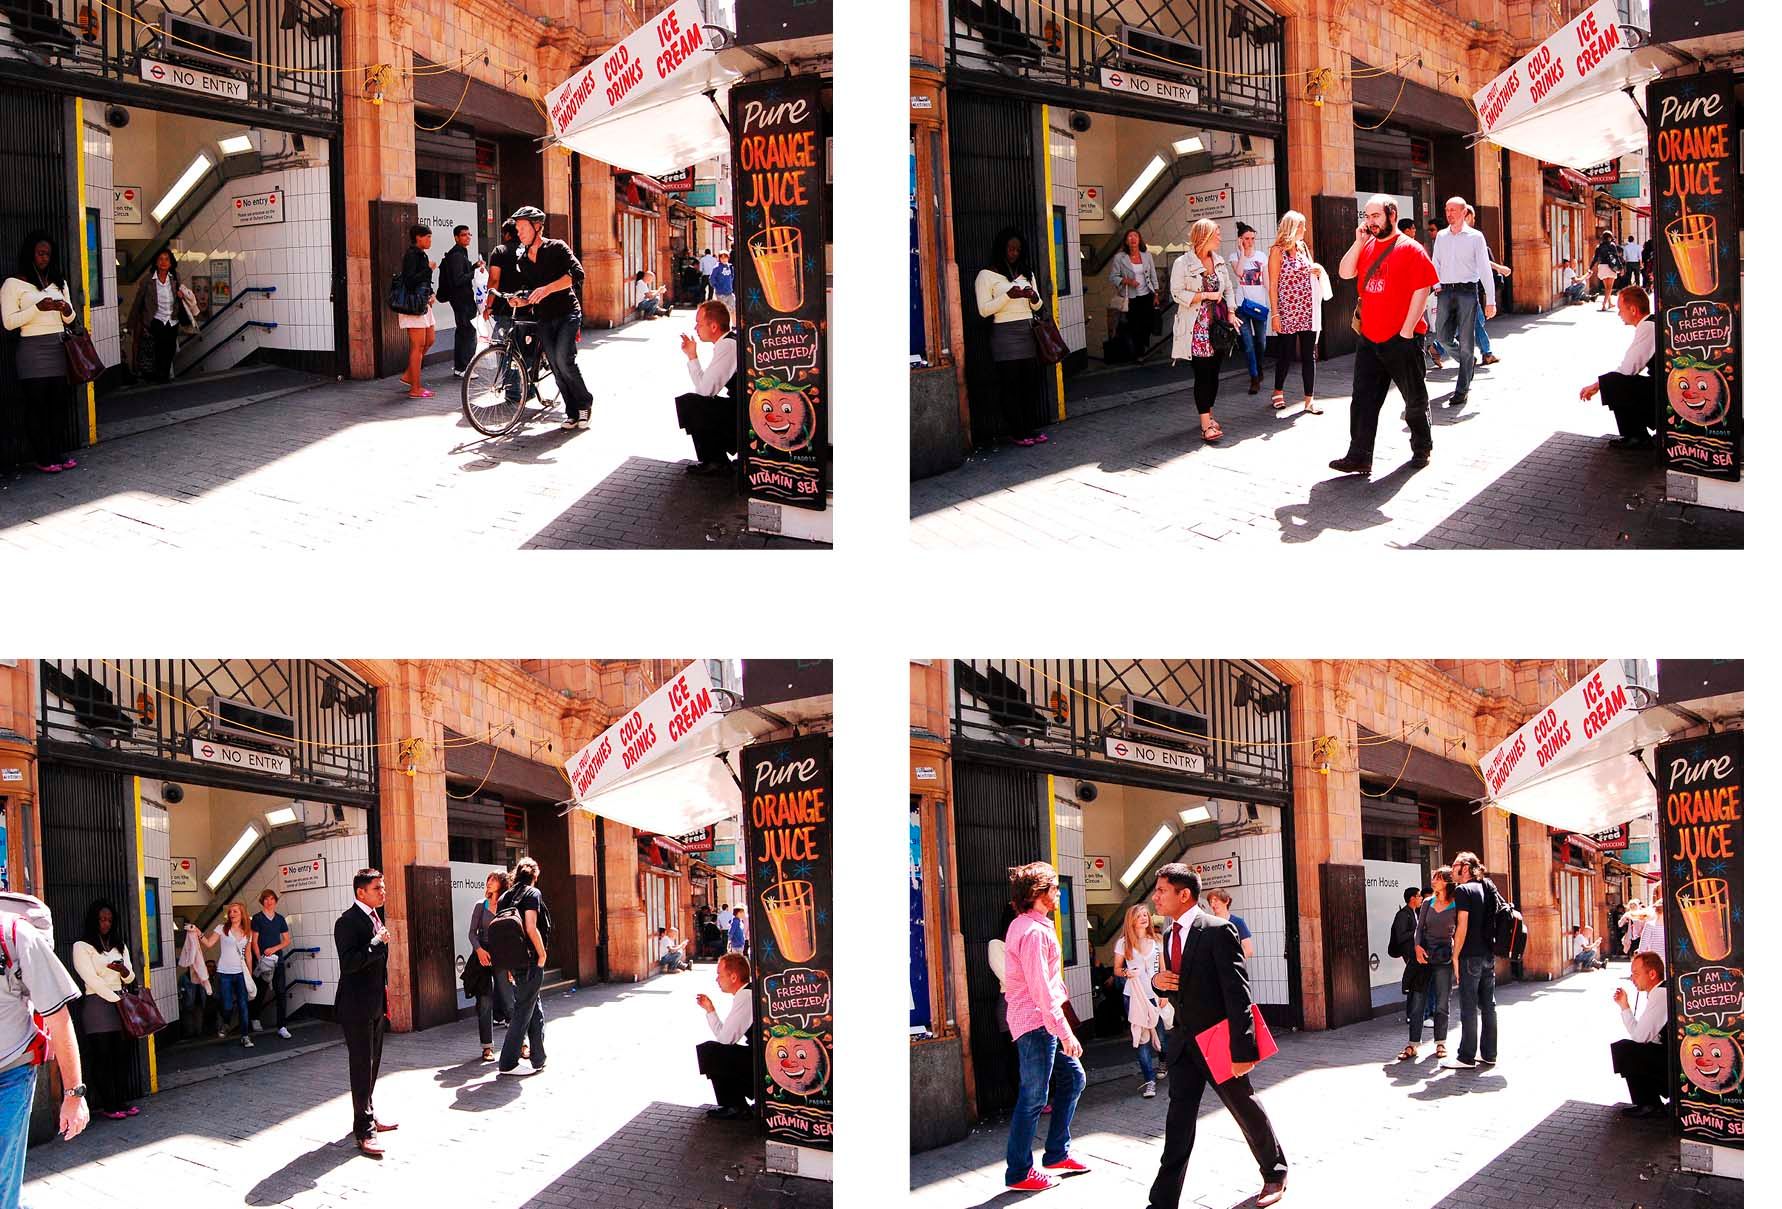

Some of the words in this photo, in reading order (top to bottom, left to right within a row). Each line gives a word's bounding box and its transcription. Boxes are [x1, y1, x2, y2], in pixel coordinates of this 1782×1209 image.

[656, 10, 680, 47] ICE
[1576, 11, 1598, 47] ICE
[604, 45, 628, 82] COLD
[656, 23, 703, 79] CREAM
[1528, 46, 1551, 80] COLD
[1576, 24, 1620, 76] CREAM
[173, 70, 195, 85] NO
[202, 76, 240, 95] ENTRY
[560, 83, 572, 101] FRUIT
[606, 58, 643, 106] DRINKS
[1130, 77, 1150, 91] NO
[1156, 82, 1191, 100] ENTRY
[1530, 57, 1564, 103] DRINKS
[558, 70, 596, 133] SMOOTHIES
[1485, 70, 1520, 129] SMOOTHIES
[1661, 94, 1723, 126] Pure
[744, 100, 810, 133] Pure
[741, 131, 816, 171] ORANGE
[1658, 124, 1729, 162] ORANGE
[746, 170, 808, 206] JUICE
[1663, 162, 1722, 196] JUICE
[243, 199, 251, 208] No
[252, 198, 268, 207] entry
[1204, 194, 1218, 202] entry
[432, 216, 454, 227] House
[1680, 316, 1722, 329] FRESHLY
[1692, 307, 1707, 316] AM
[762, 334, 808, 348] FRESHLY
[776, 324, 792, 334] AM
[1674, 326, 1730, 343] SQUEEZED!
[757, 344, 816, 363] SQUEEZED!
[1668, 444, 1708, 461] VITAMIN
[1713, 453, 1732, 466] SEA
[750, 470, 792, 488] VITAMIN
[798, 480, 818, 494] SEA
[668, 676, 690, 712] ICE
[1583, 673, 1605, 709] ICE
[668, 688, 712, 742] CREAM
[1534, 709, 1557, 744] COLD
[1583, 685, 1627, 739] CREAM
[620, 712, 643, 746] COLD
[1536, 720, 1571, 767] DRINKS
[222, 748, 242, 762] NO
[248, 753, 283, 771] ENTRY
[622, 723, 657, 769] DRINKS
[1136, 747, 1156, 761] NO
[1162, 751, 1197, 769] ENTRY
[577, 737, 613, 797] SMOOTHIES
[755, 759, 819, 791] Pure
[1491, 734, 1527, 794] SMOOTHIES
[1670, 756, 1734, 789] Pure
[753, 789, 825, 827] ORANGE
[1668, 787, 1740, 825] ORANGE
[758, 827, 818, 861] JUICE
[1673, 825, 1733, 859] JUICE
[289, 866, 296, 875] No
[297, 866, 311, 874] entry
[1211, 863, 1225, 871] entry
[1379, 877, 1399, 888] House
[465, 879, 485, 890] House
[777, 984, 821, 997] FRESHLY
[790, 974, 805, 984] AM
[1692, 982, 1736, 995] FRESHLY
[1705, 972, 1720, 982] AM
[772, 994, 829, 1011] SQUEEZED!
[1687, 992, 1744, 1010] SQUEEZED!
[767, 1114, 808, 1131] VITAMIN
[812, 1123, 833, 1136] SEA
[1681, 1112, 1723, 1130] VITAMIN
